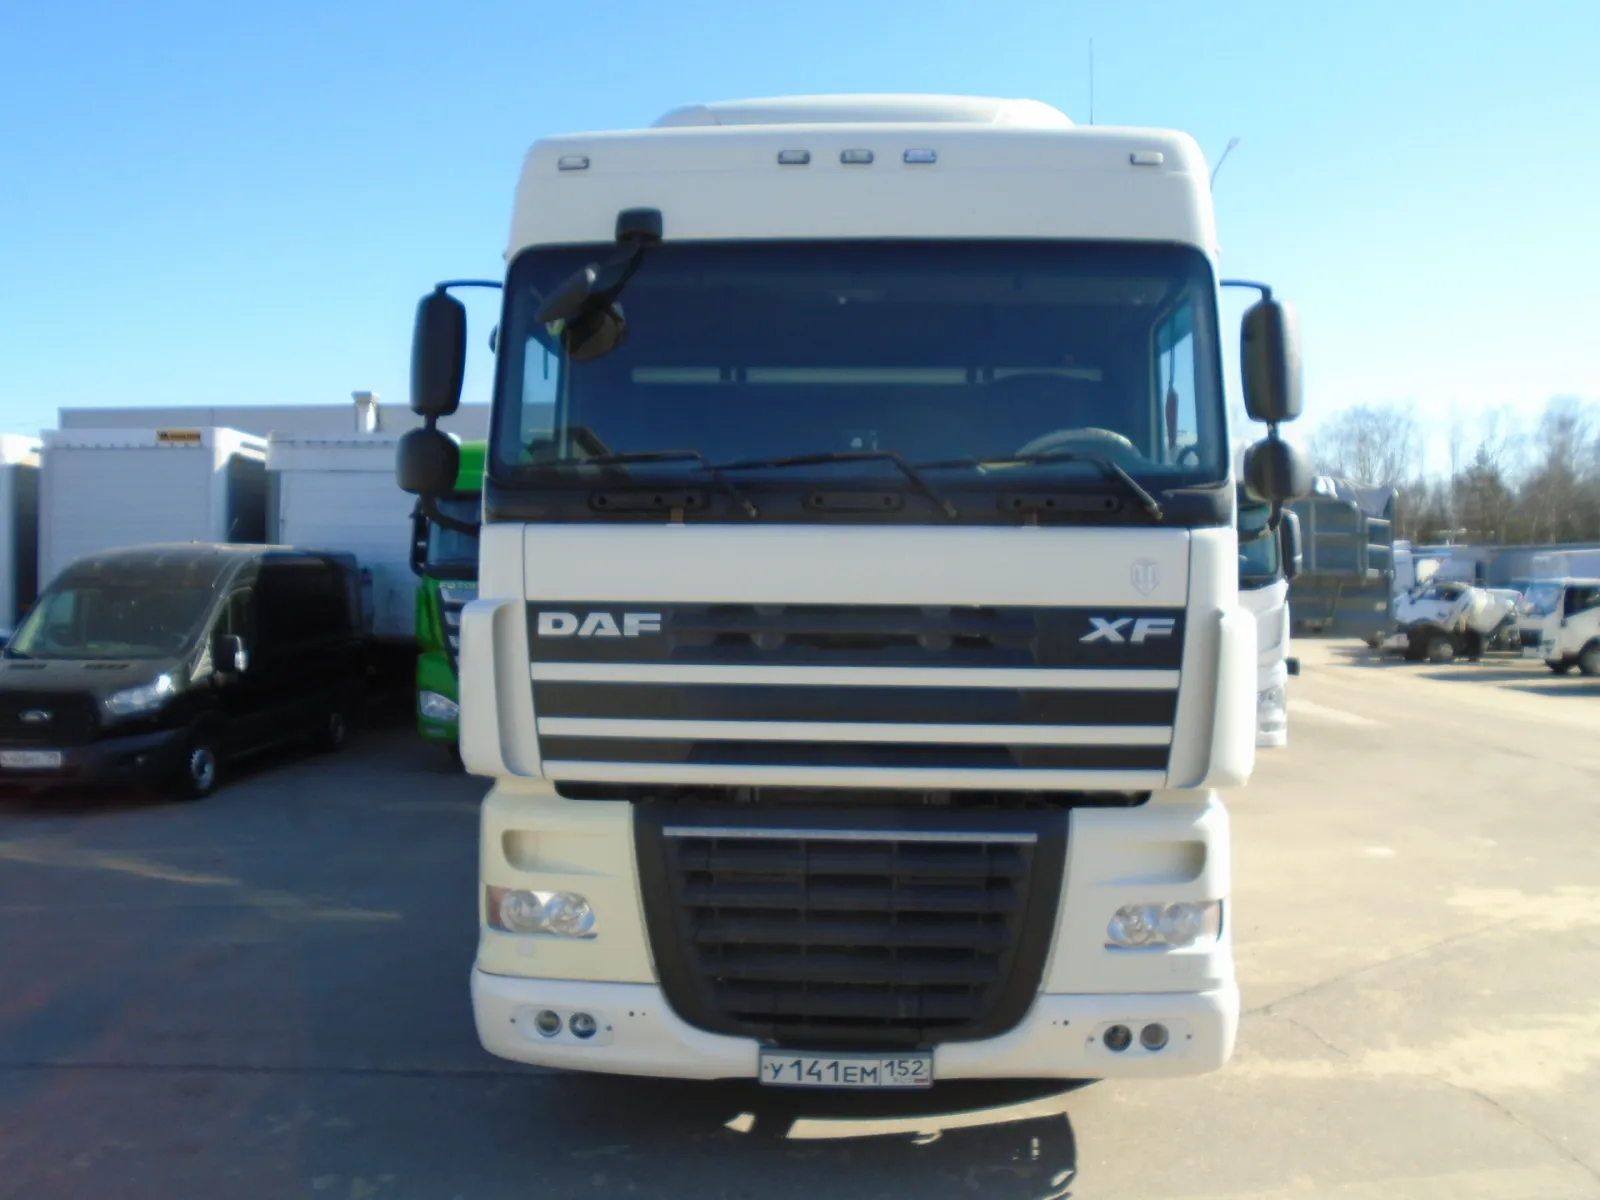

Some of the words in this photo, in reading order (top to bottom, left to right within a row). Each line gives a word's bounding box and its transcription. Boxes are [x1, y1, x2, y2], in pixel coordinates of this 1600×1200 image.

[537, 611, 662, 637] DAF
[1079, 617, 1176, 643] XF
[884, 1060, 924, 1077] 152
